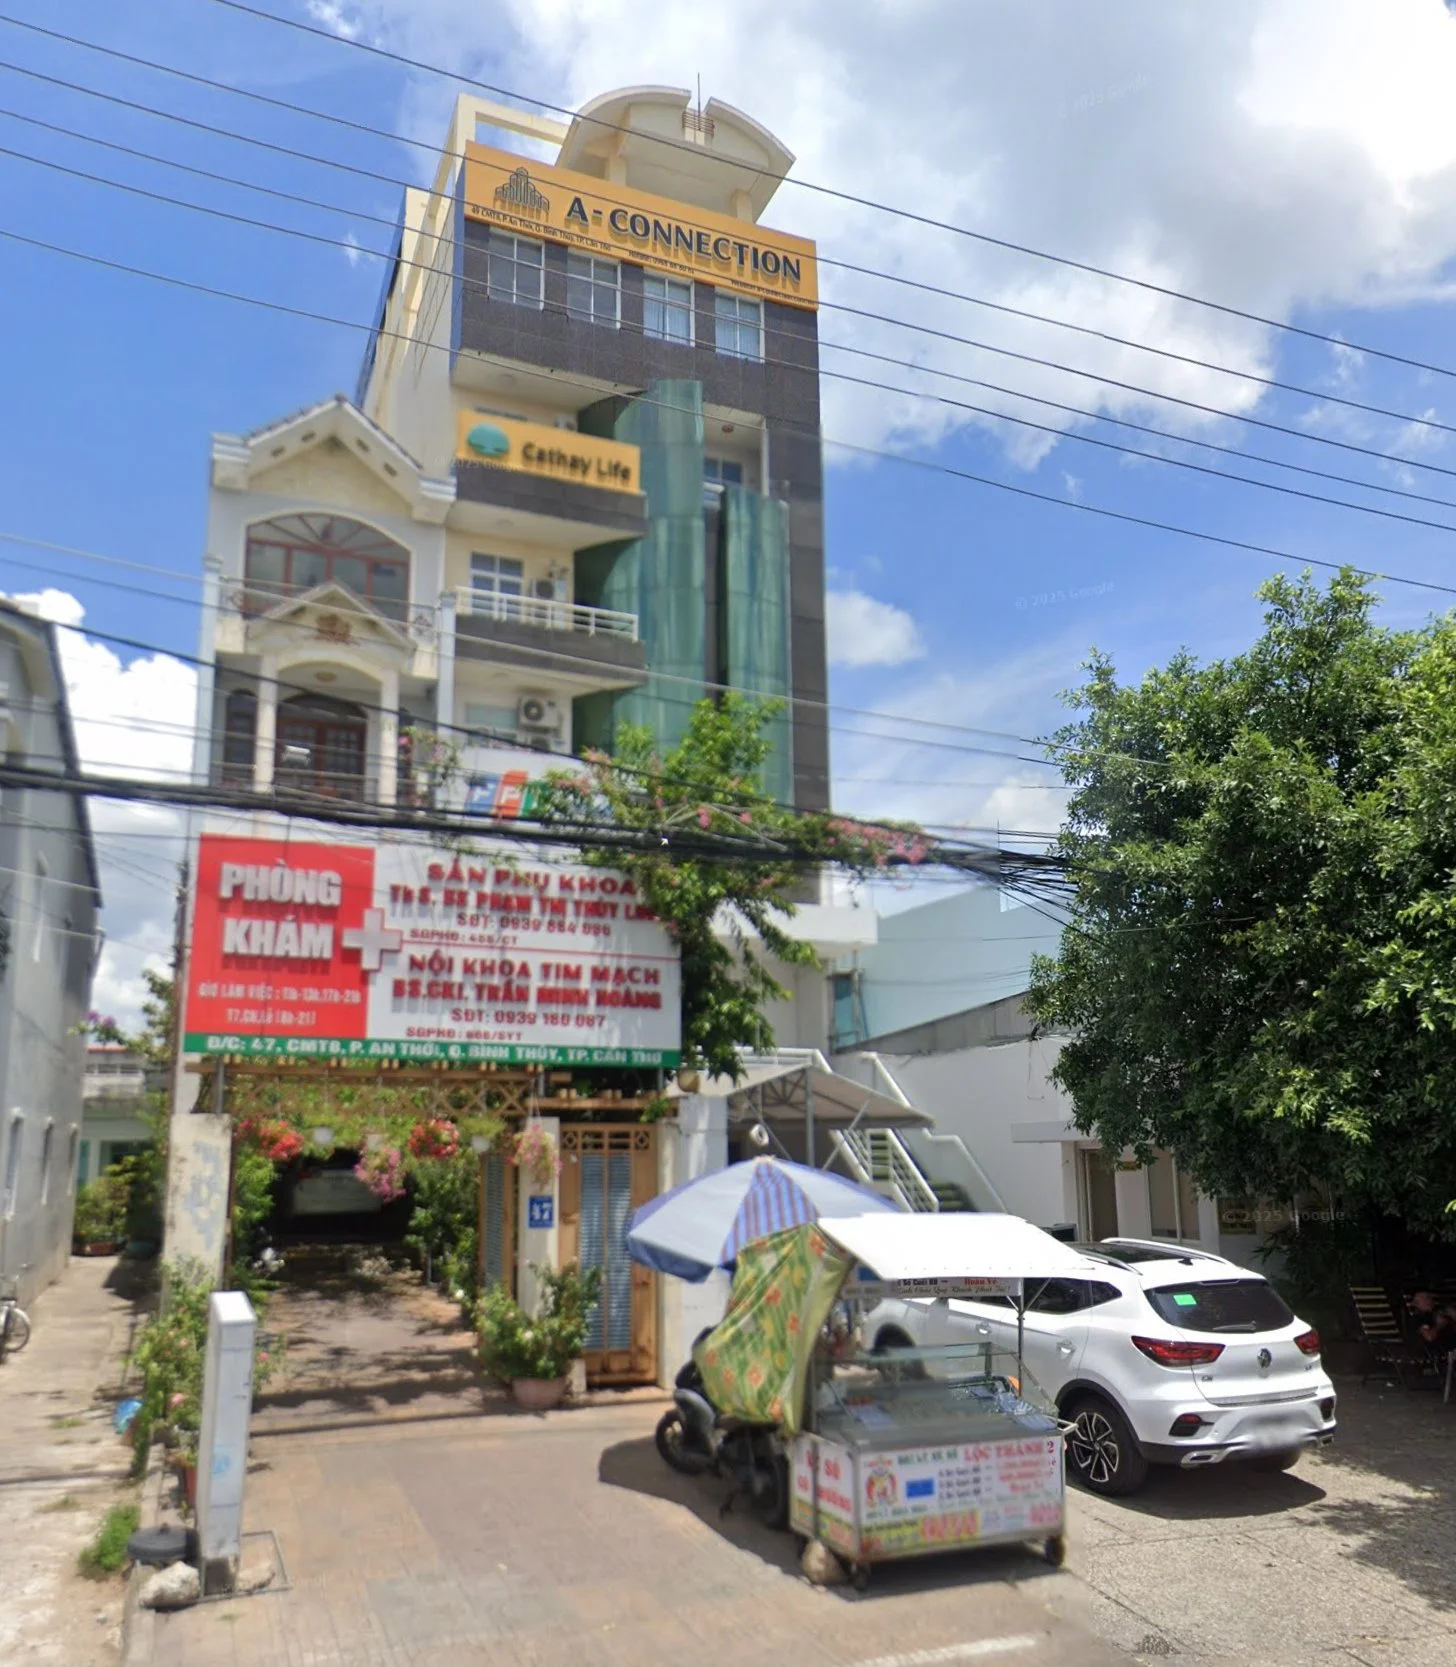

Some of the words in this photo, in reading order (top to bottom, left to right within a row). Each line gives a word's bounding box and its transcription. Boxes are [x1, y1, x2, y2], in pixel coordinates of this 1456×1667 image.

[566, 196, 589, 224] A
[609, 207, 801, 283] CONNECTION
[521, 441, 592, 477] Cathay
[597, 457, 632, 482] Life
[219, 857, 342, 907] PHÒNG
[558, 872, 638, 896] KHOA
[222, 914, 334, 960] KHÁM
[409, 948, 454, 978] NỘI
[462, 957, 532, 979] KHOA
[541, 961, 582, 981] TIM
[590, 964, 660, 987] MẠCH
[494, 1009, 537, 1025] 0939
[368, 1042, 397, 1057] AN
